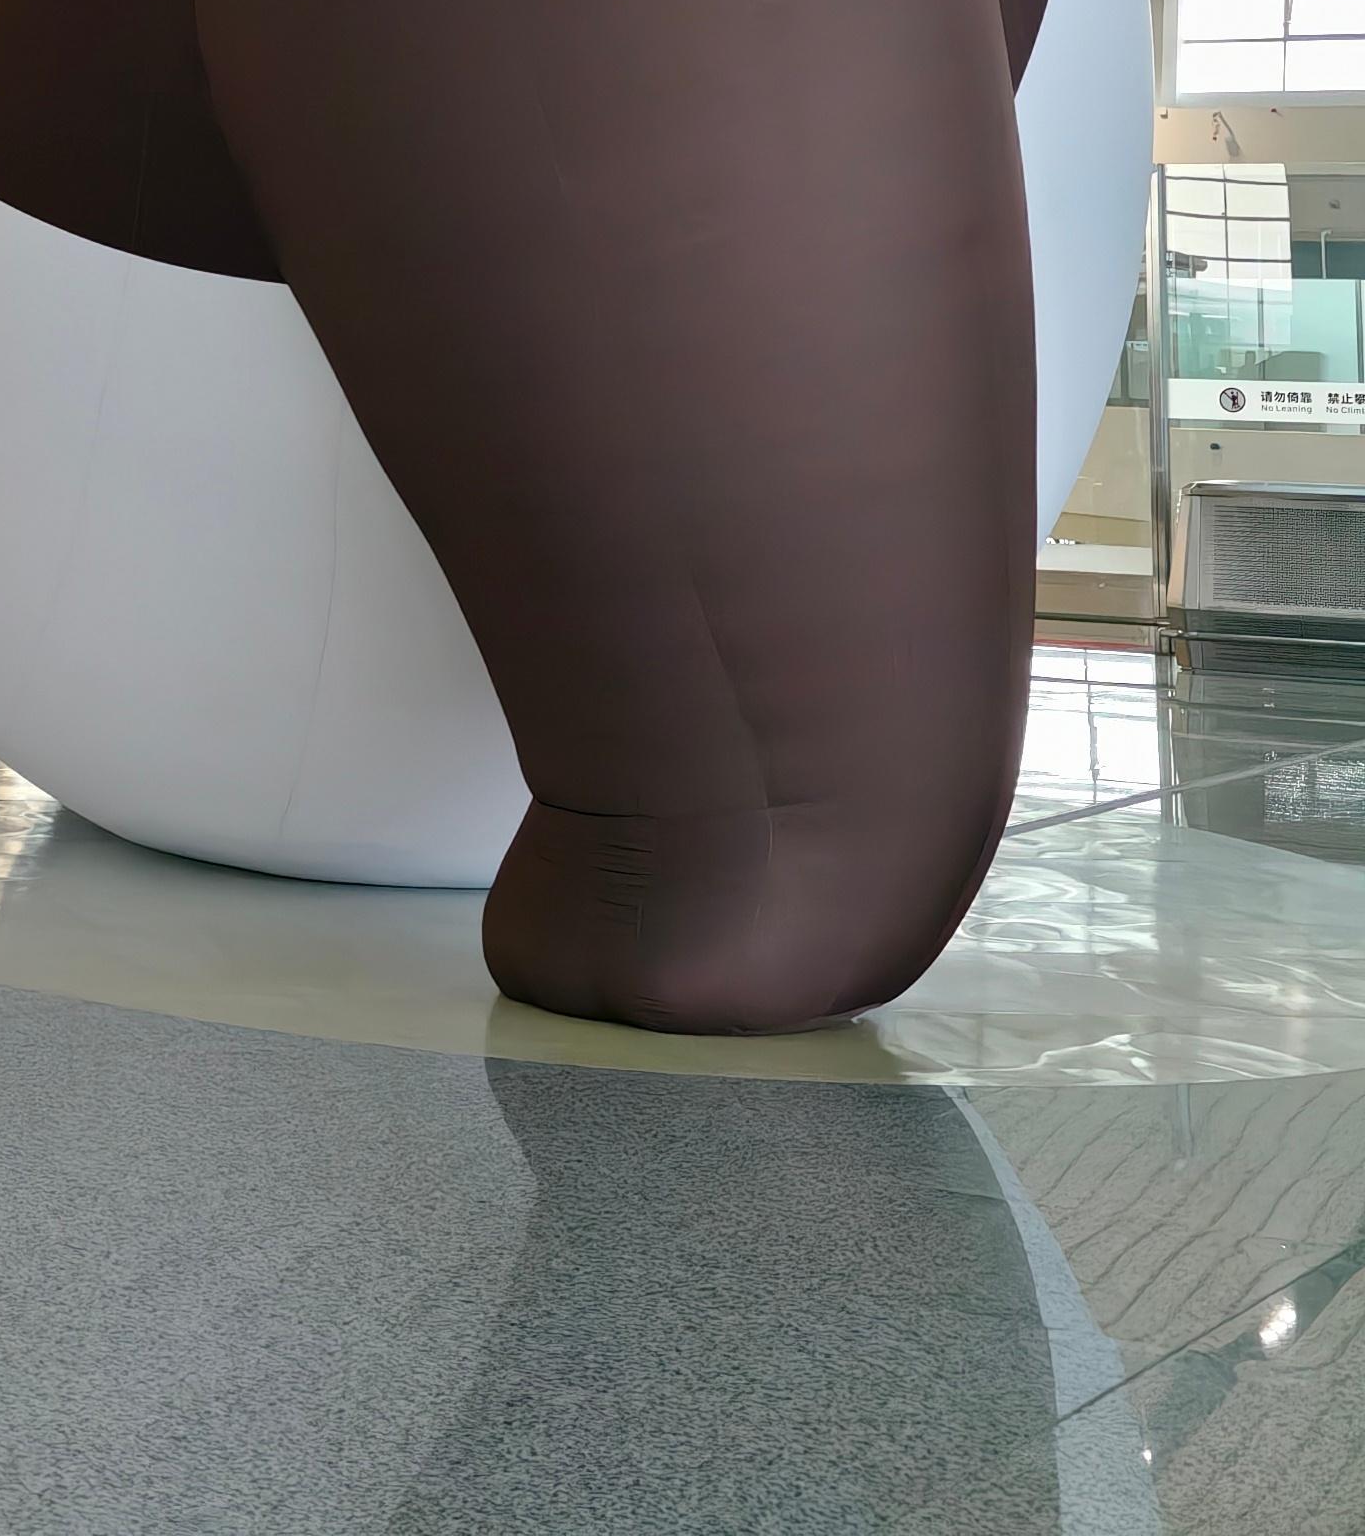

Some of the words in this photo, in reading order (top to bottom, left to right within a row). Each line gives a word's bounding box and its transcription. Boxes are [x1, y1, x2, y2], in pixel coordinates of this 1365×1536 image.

[1261, 391, 1312, 403] 请勿倚靠
[1276, 405, 1313, 415] Leaning
[1341, 407, 1365, 415] Clim
